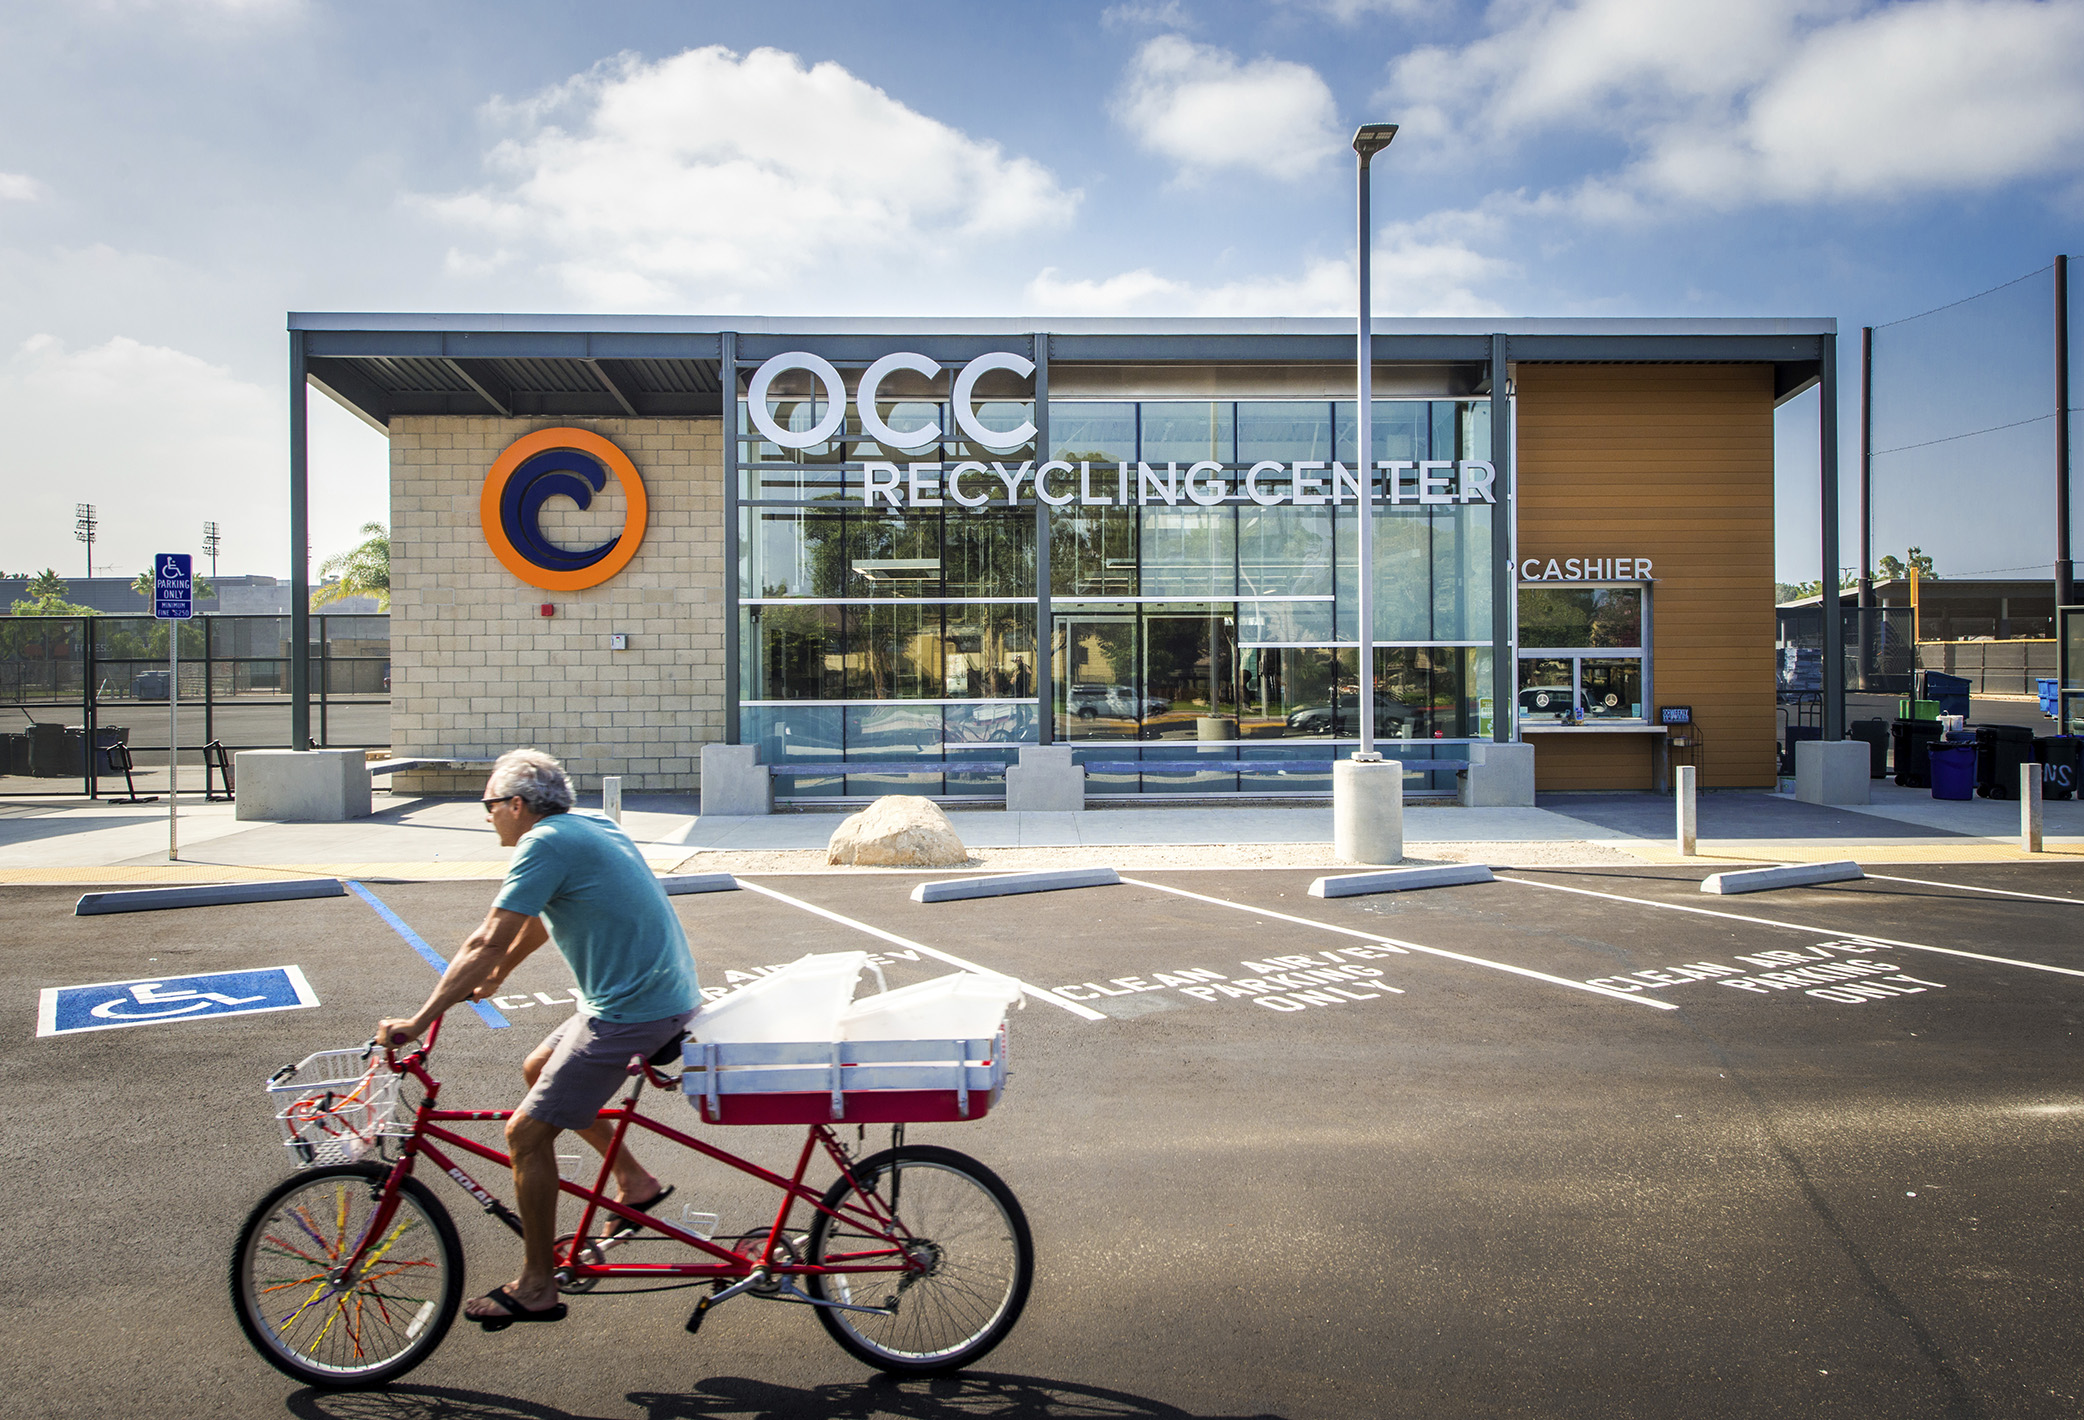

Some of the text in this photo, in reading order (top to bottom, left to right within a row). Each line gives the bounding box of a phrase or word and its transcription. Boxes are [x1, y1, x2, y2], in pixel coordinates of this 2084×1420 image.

[748, 351, 1038, 448] OCC
[864, 459, 1497, 508] RECYCLING CENTER
[157, 579, 190, 589] PARKING
[1521, 558, 1653, 580] CASHIER
[163, 589, 184, 599] ONLY
[1051, 967, 1228, 1000] CLEAN
[1178, 964, 1384, 1002] PARKING
[1585, 961, 1746, 993] CLEAN
[1717, 958, 1900, 994] PARKING
[1805, 973, 1947, 1004] ONLY
[1253, 979, 1405, 1012] ONLY
